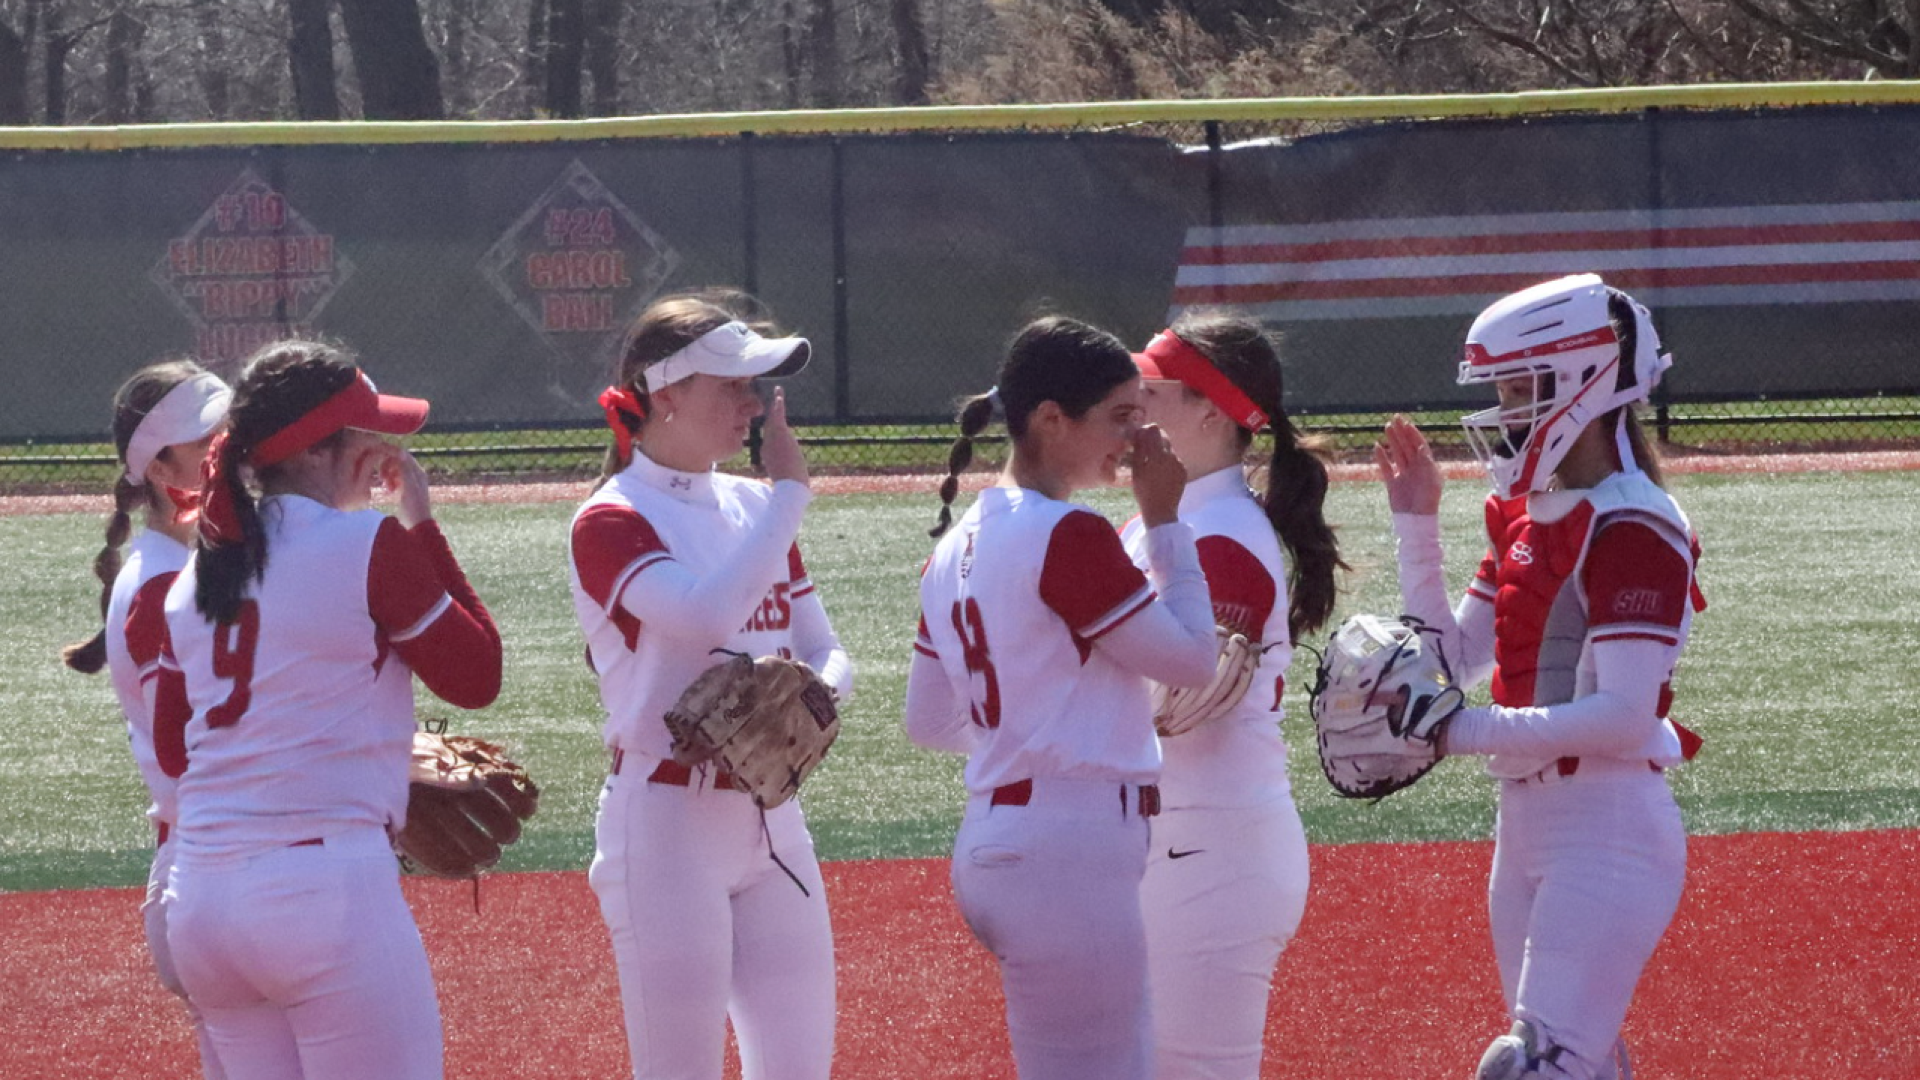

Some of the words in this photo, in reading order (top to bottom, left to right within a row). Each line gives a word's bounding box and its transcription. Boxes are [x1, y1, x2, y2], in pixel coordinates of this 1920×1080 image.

[215, 191, 287, 231] #10
[544, 208, 616, 246] #24
[168, 235, 335, 275] ELIZABETH
[528, 250, 632, 289] CAROL
[1614, 588, 1661, 614] SHU
[206, 597, 260, 729] 9
